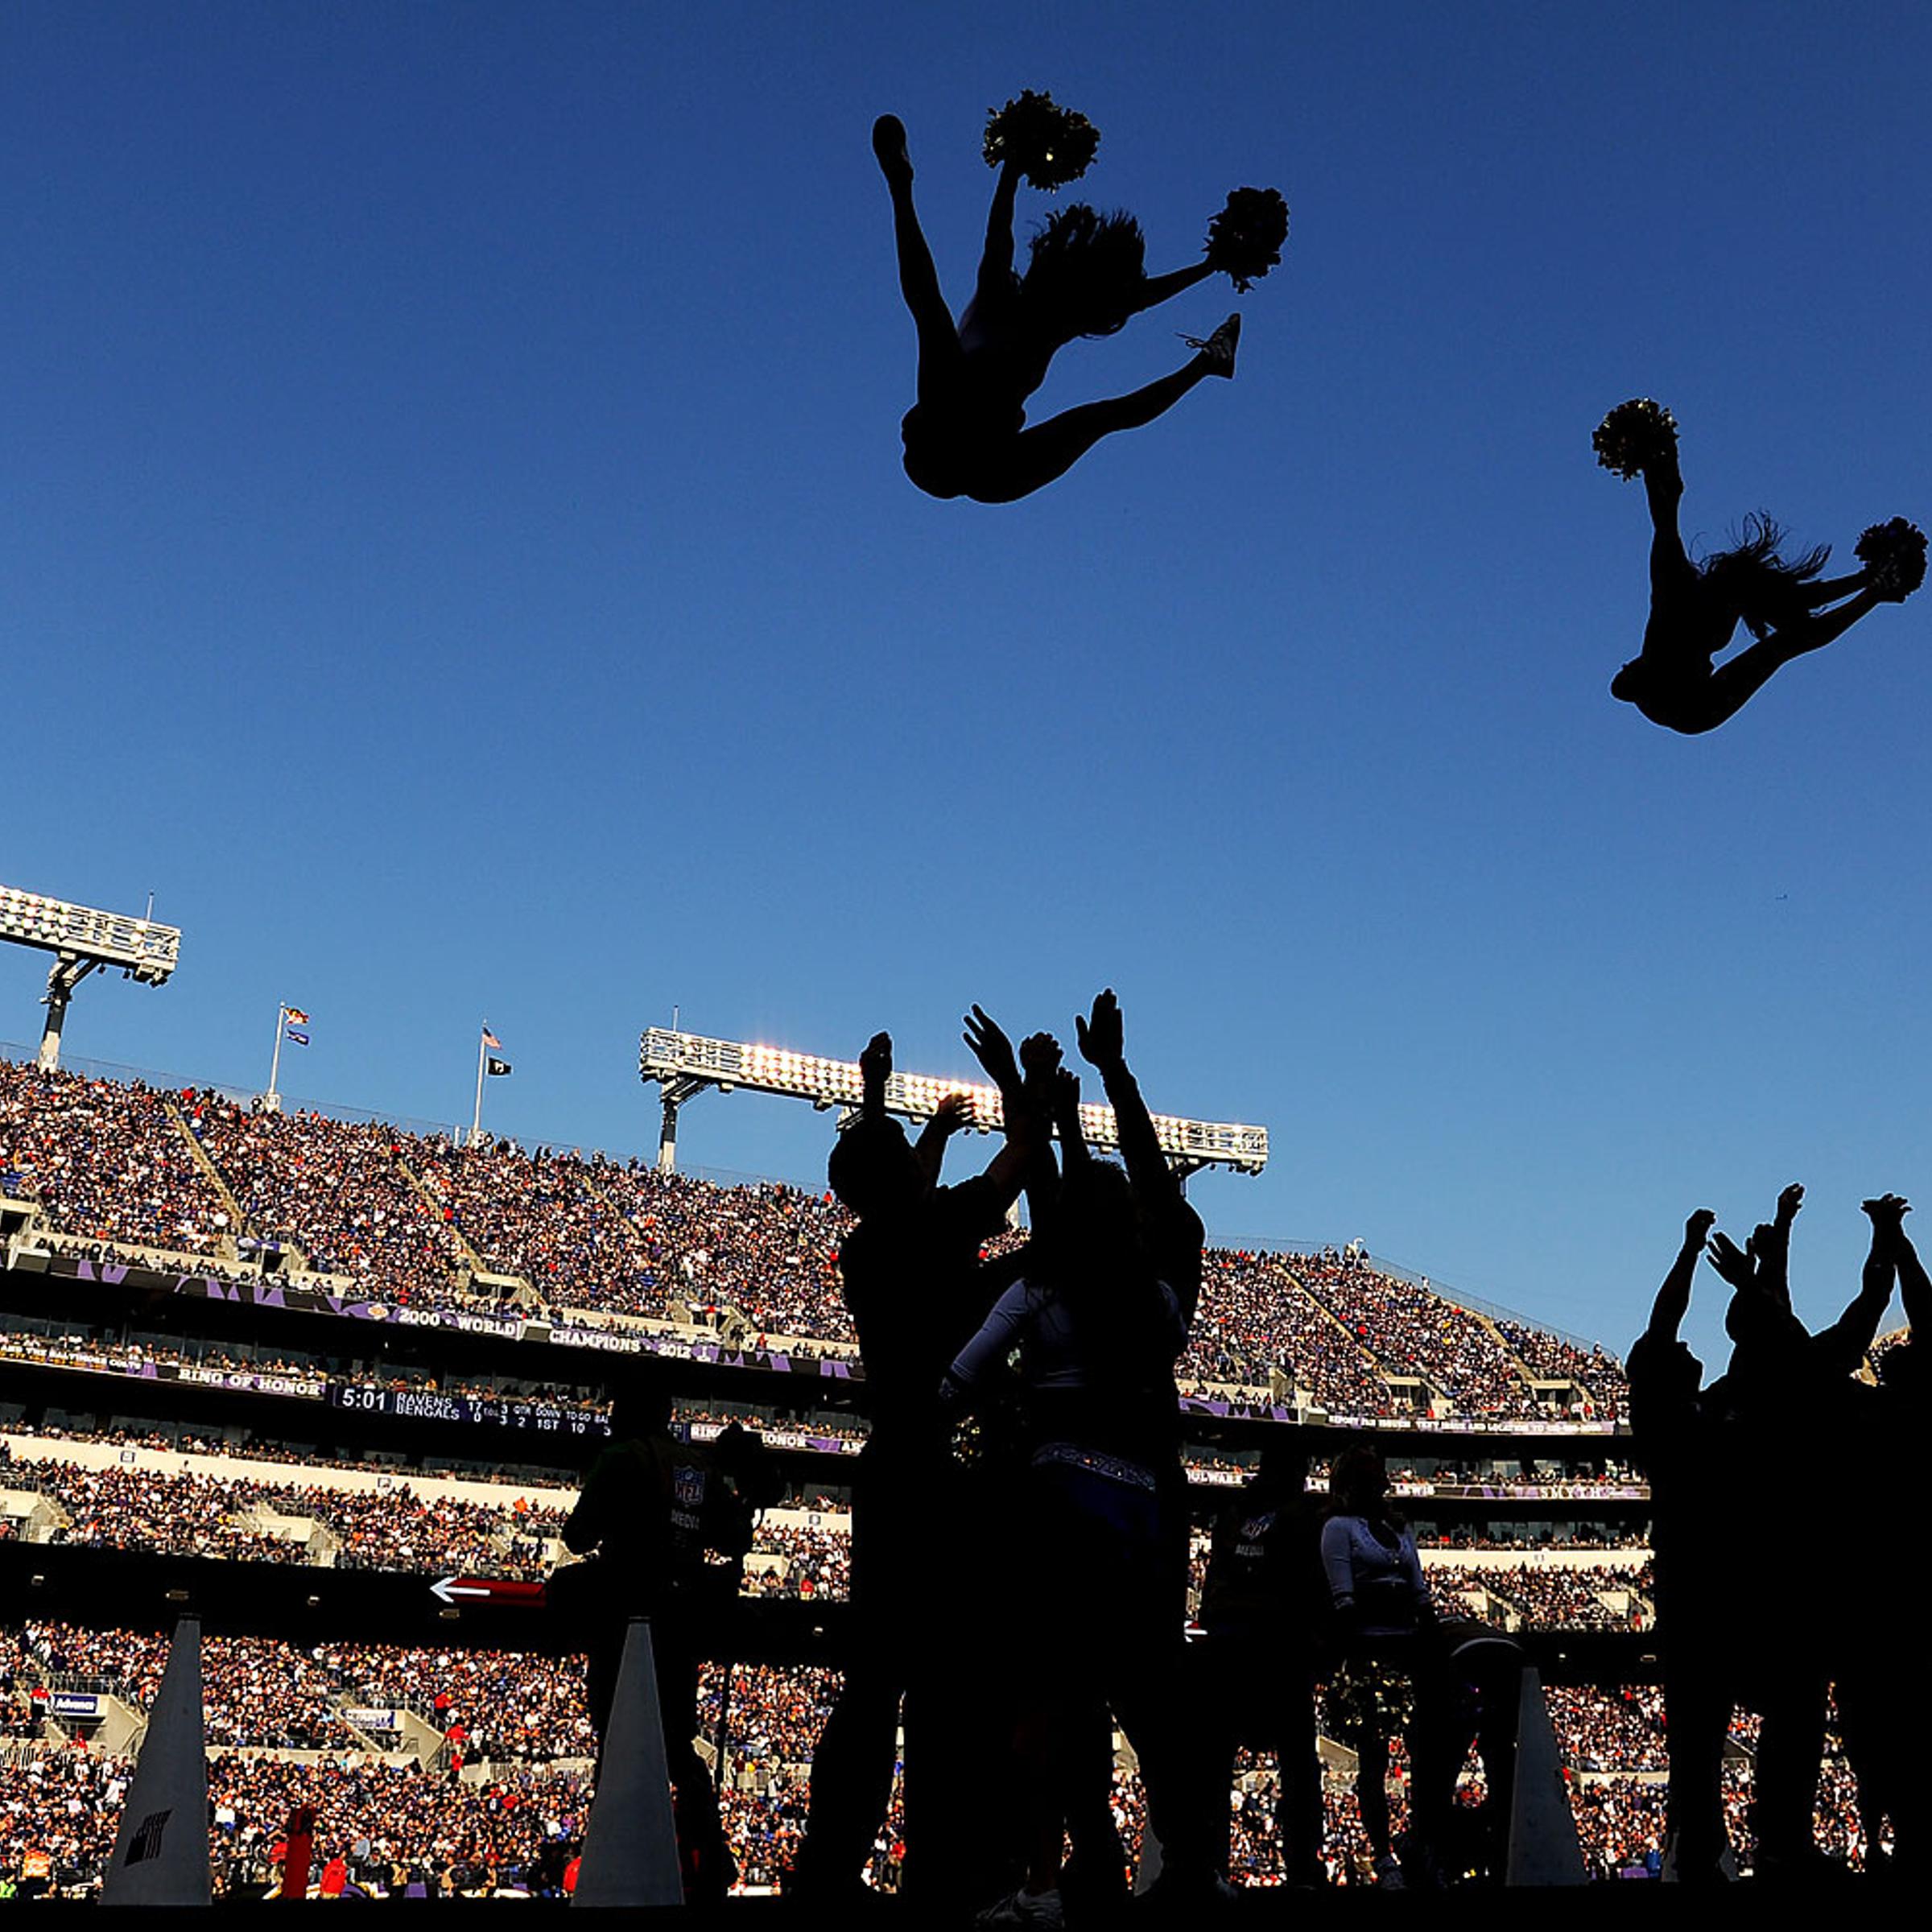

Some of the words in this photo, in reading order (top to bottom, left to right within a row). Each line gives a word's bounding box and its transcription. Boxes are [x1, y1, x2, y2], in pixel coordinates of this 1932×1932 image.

[399, 1309, 440, 1326] 2000
[457, 1316, 516, 1335] WORLD
[549, 1330, 640, 1352] CHAMPIONS
[658, 1343, 691, 1359] 2012
[178, 1369, 224, 1385] RING
[229, 1375, 253, 1388] OF
[258, 1379, 320, 1396] HONOR
[342, 1388, 386, 1410] 5:01
[397, 1392, 453, 1410] RAVENS
[469, 1402, 483, 1412] 17
[502, 1404, 509, 1414] 3
[514, 1406, 531, 1416] QTR
[535, 1407, 561, 1418] DOWN
[566, 1411, 577, 1420] TO
[578, 1412, 592, 1422] GO
[396, 1403, 460, 1421] BENGALS
[473, 1413, 482, 1423] 0
[500, 1415, 508, 1426] 3
[518, 1417, 526, 1428] 2
[537, 1419, 560, 1430] 1ST
[572, 1422, 586, 1434] 10
